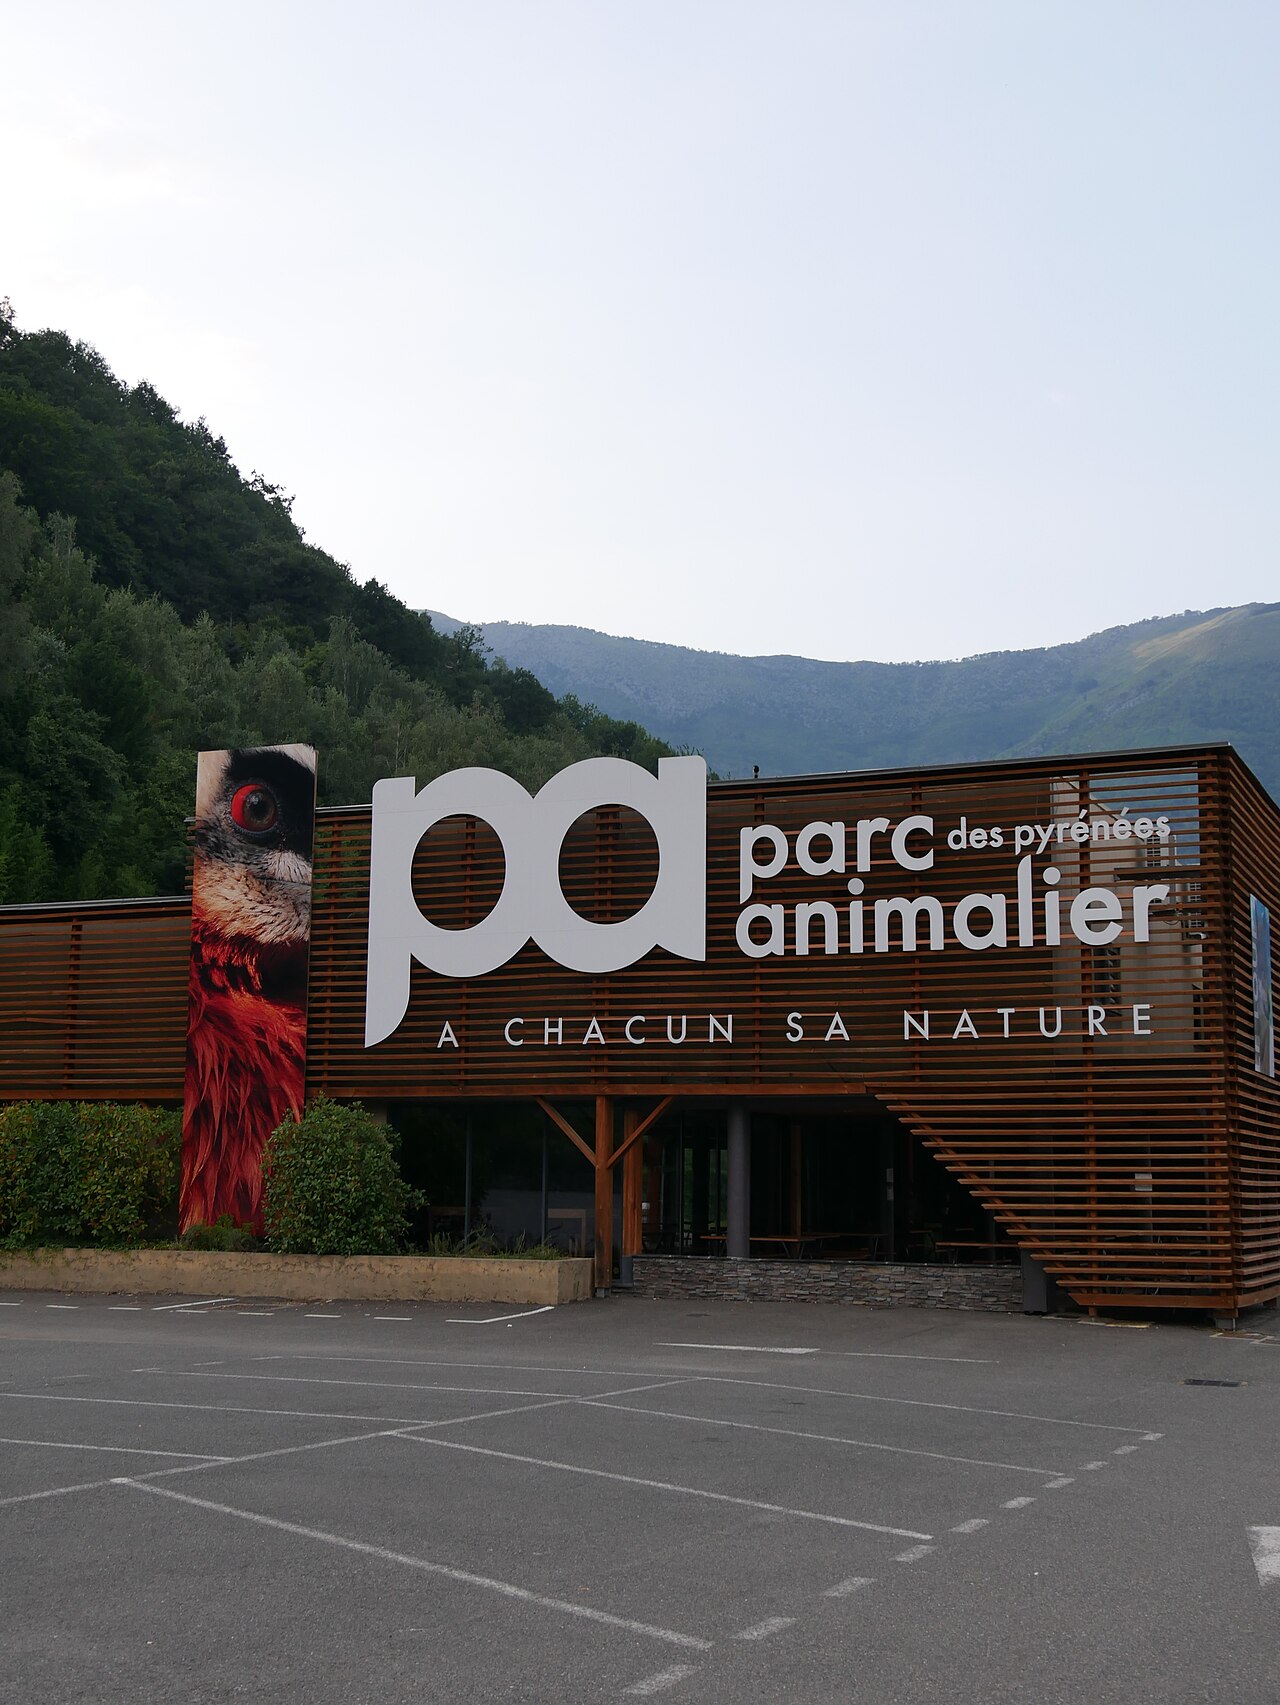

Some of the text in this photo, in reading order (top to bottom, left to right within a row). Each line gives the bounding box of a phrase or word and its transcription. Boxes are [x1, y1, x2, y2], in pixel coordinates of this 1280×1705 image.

[739, 815, 934, 904] parc
[947, 806, 1171, 855] des pyrénées
[365, 755, 707, 1047] pa
[735, 854, 1170, 958] animalier
[437, 1003, 1153, 1048] A CHACUN SA NATURE
